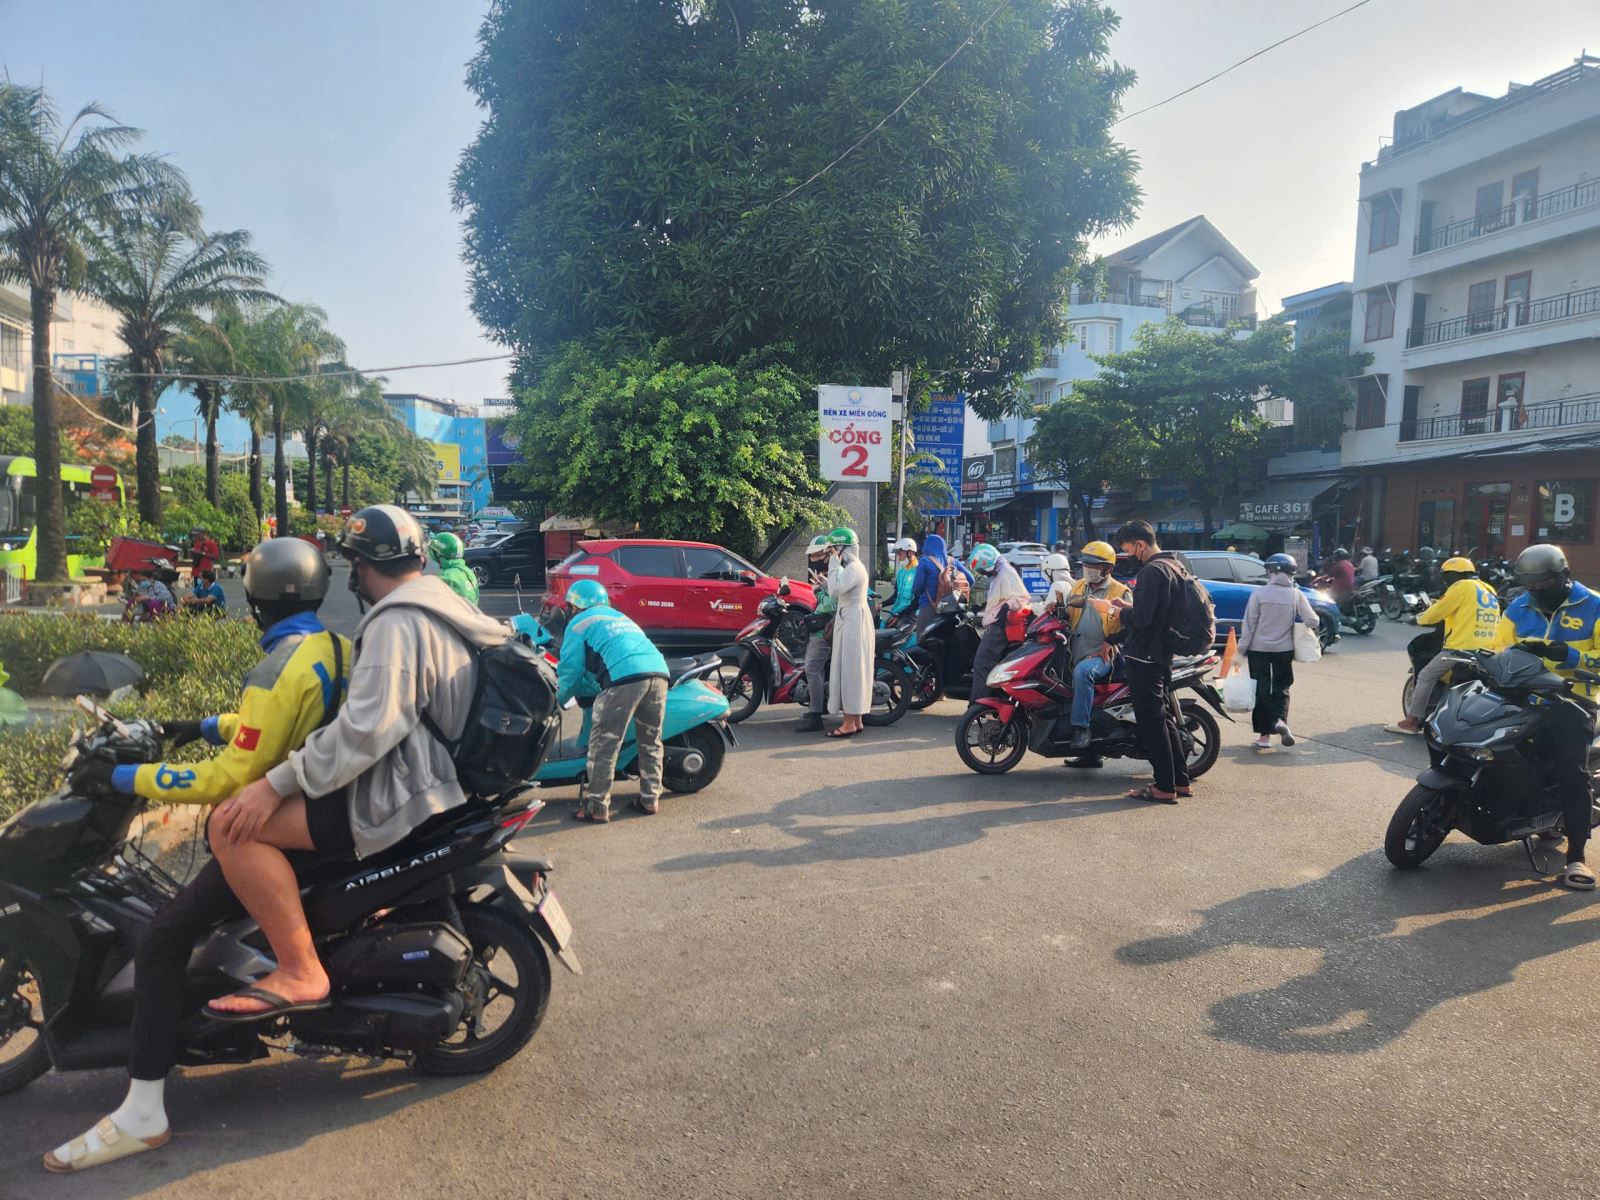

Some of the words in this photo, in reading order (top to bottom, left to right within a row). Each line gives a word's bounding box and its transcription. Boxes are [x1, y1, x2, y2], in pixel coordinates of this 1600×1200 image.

[829, 422, 882, 445] CỔNG
[841, 444, 869, 478] 2
[1283, 502, 1309, 513] 361
[1554, 493, 1575, 523] B
[1560, 611, 1584, 631] be
[156, 764, 196, 790] be
[344, 845, 452, 892] AIRBLADE
